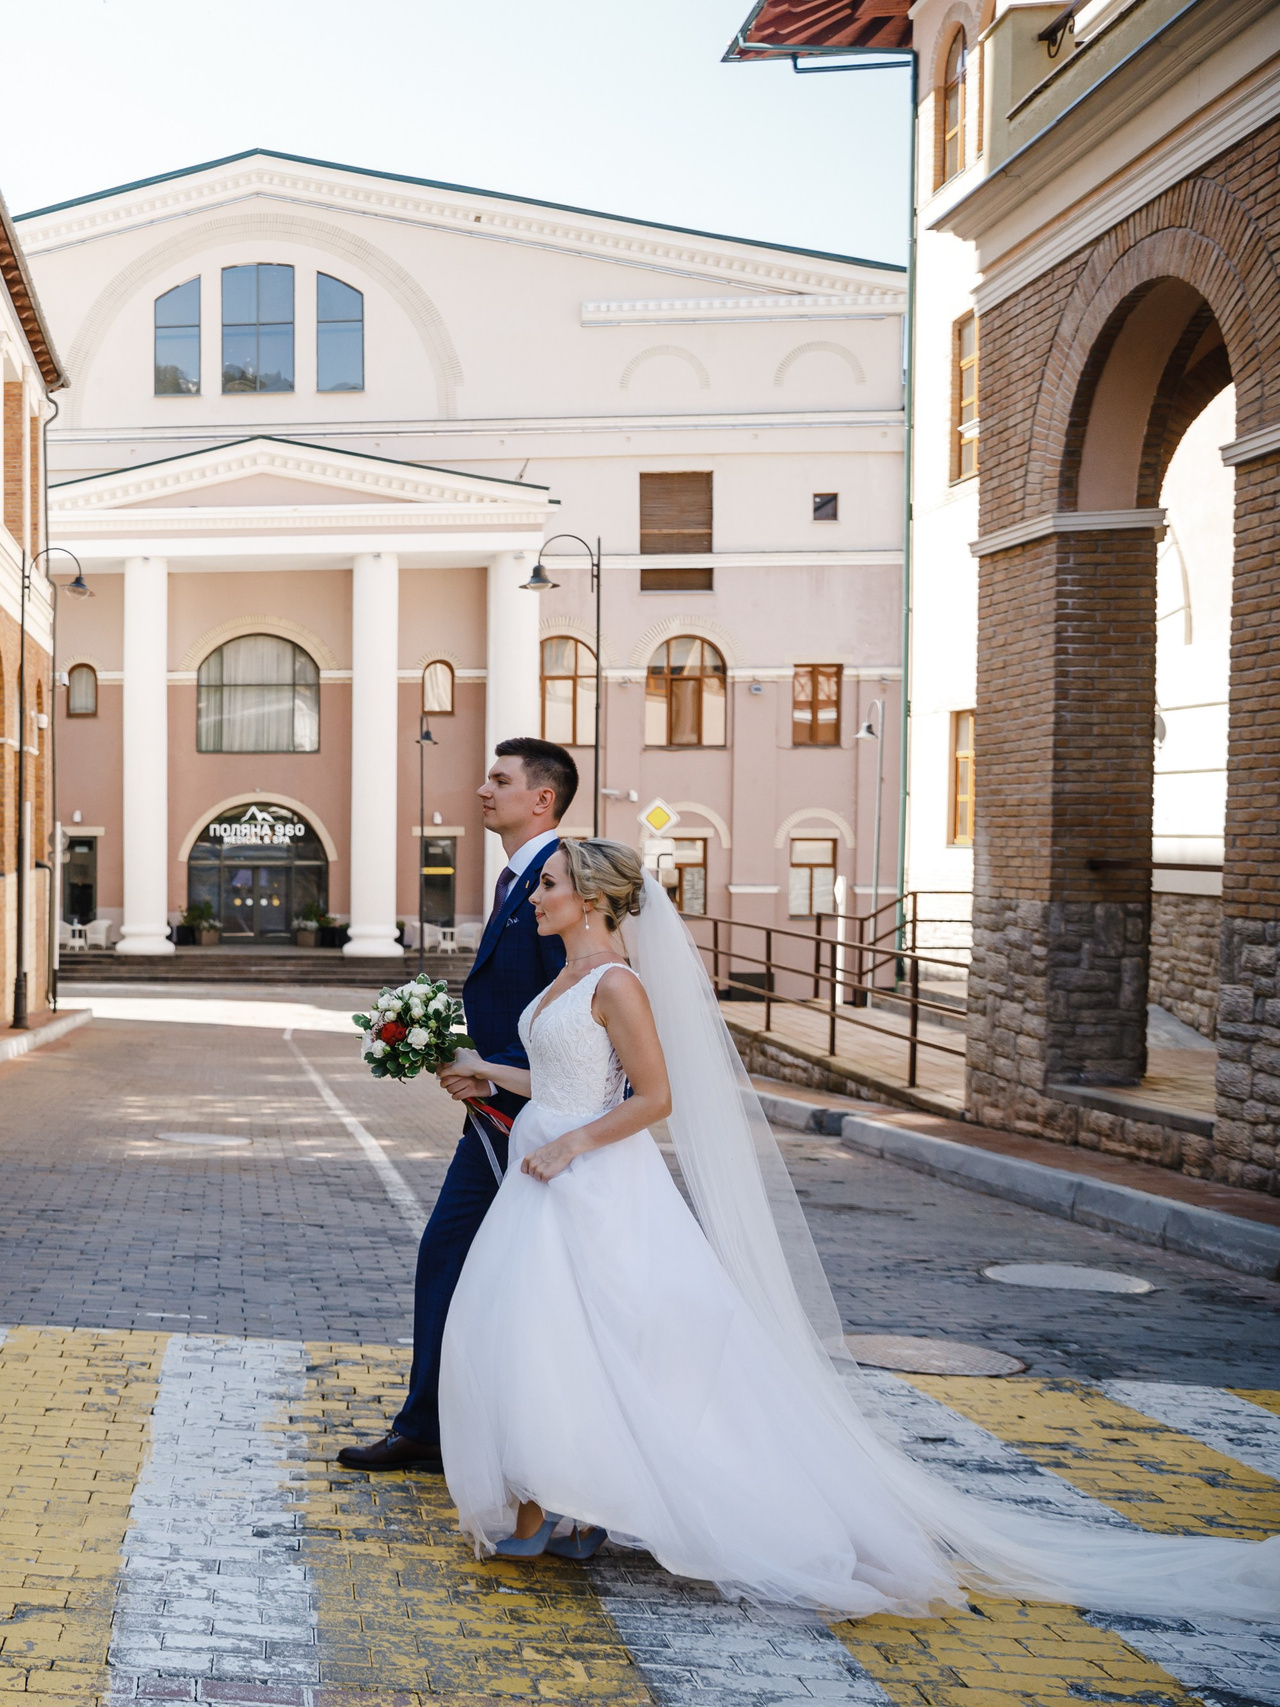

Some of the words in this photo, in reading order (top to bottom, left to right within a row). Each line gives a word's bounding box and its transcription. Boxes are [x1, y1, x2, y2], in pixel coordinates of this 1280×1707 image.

[209, 823, 272, 837] ПОЛЯНА
[274, 823, 305, 836] 960
[223, 836, 262, 844] MEDICAL
[264, 836, 271, 844] &
[272, 836, 291, 844] SPA
